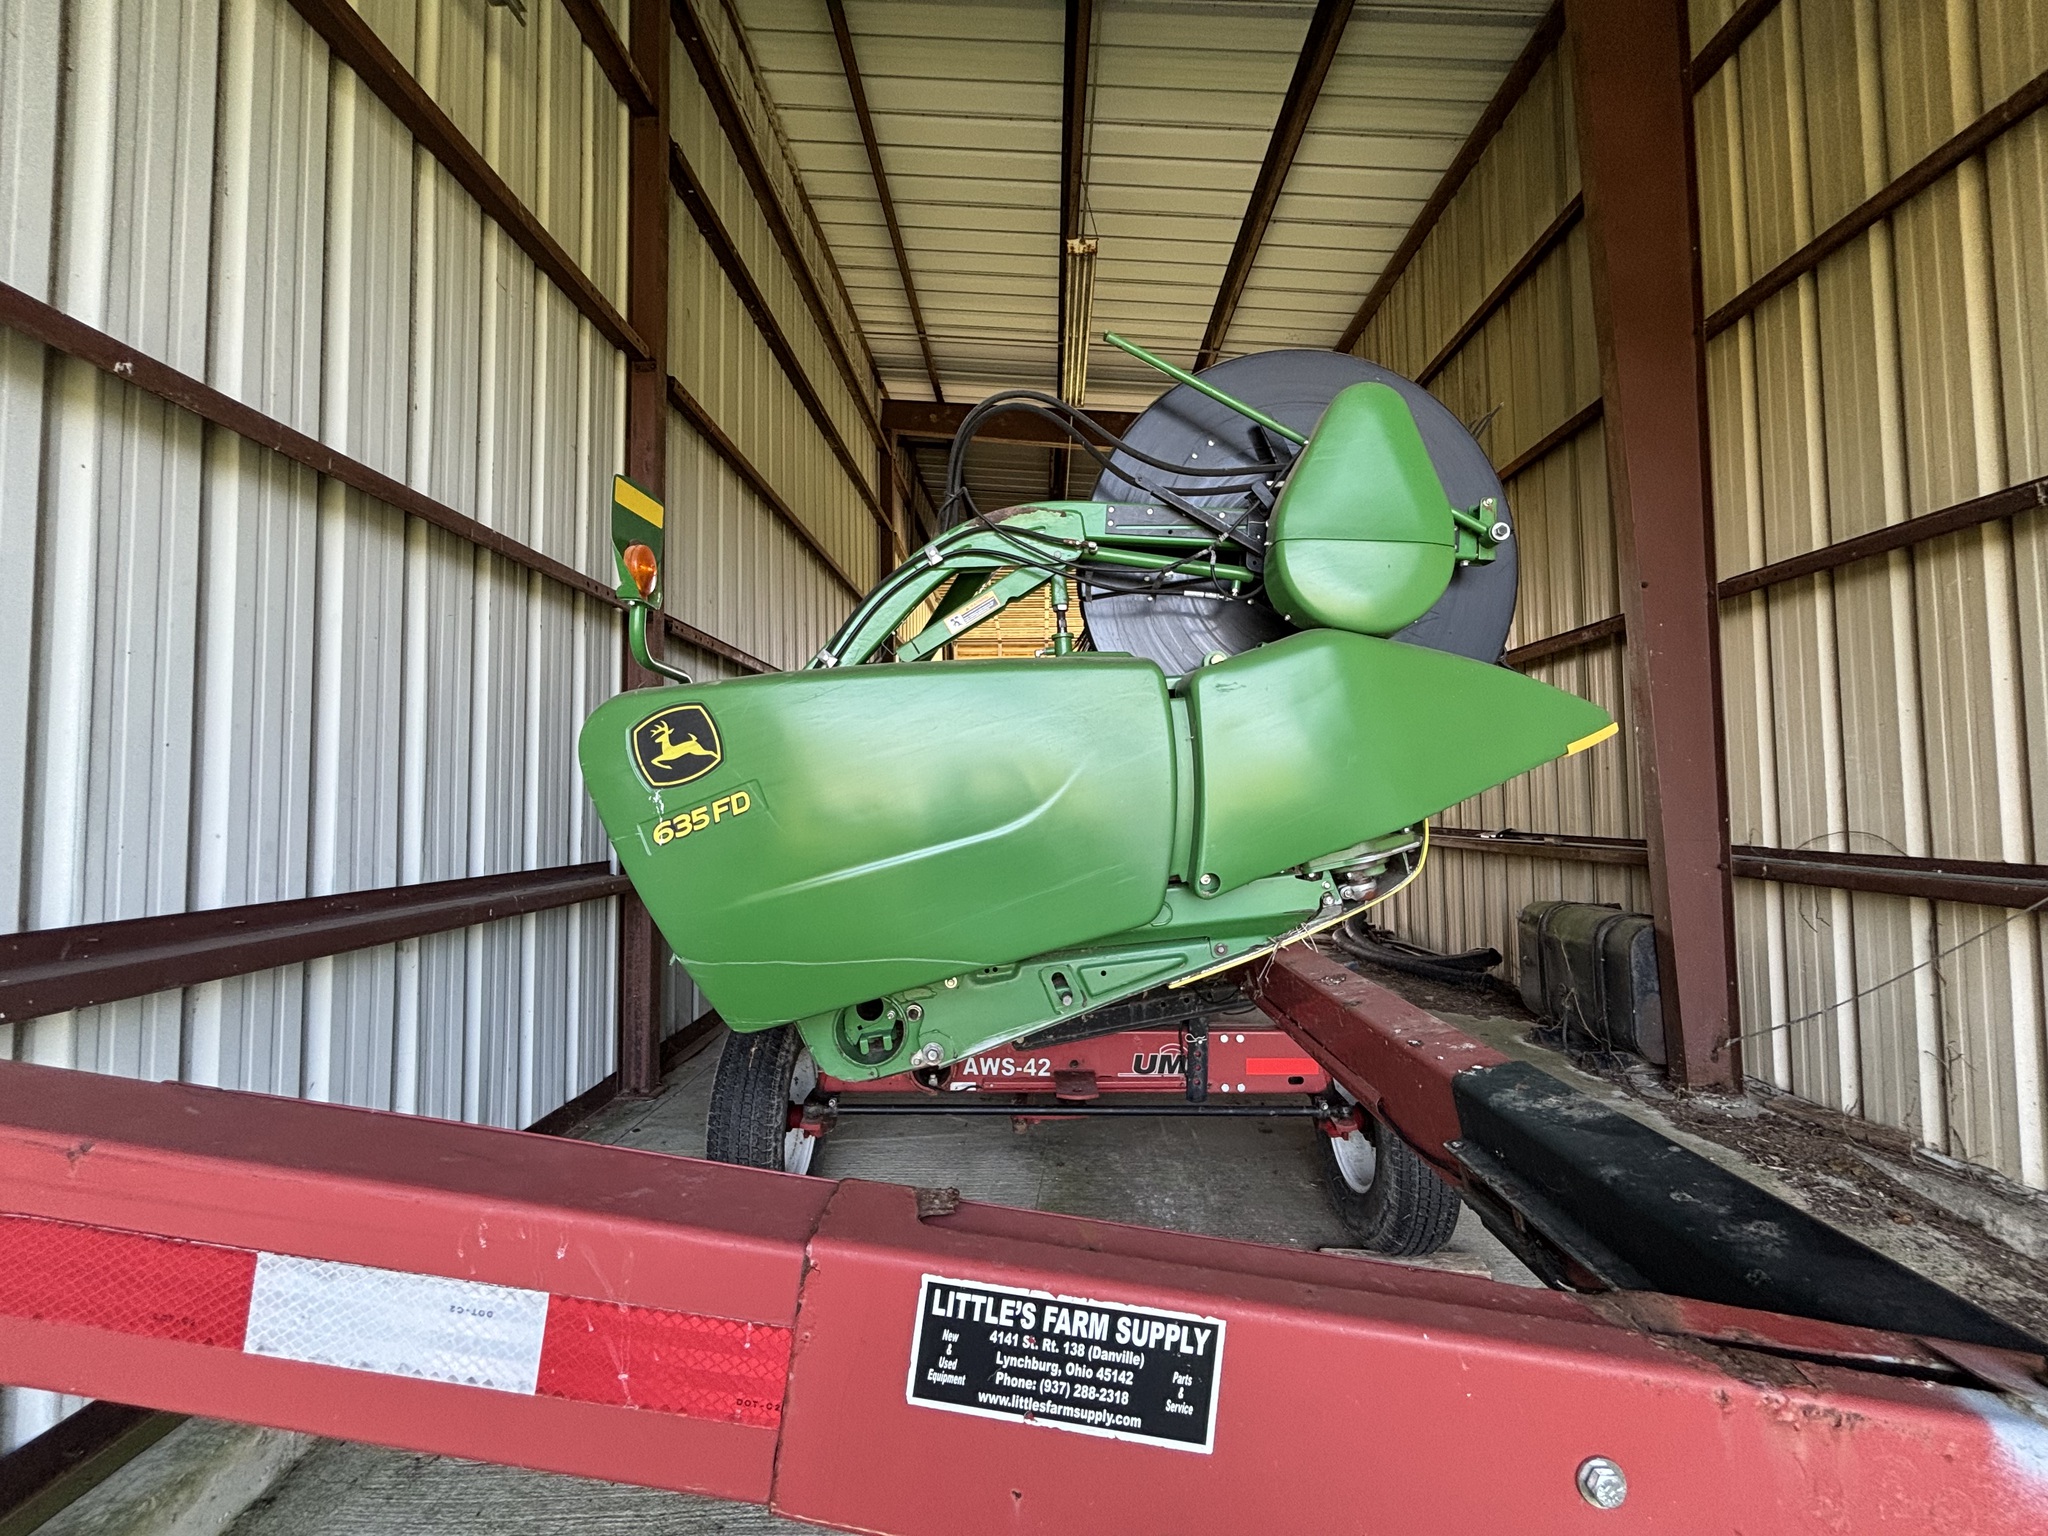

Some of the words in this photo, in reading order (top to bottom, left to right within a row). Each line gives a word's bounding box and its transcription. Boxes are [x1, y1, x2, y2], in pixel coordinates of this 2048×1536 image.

[962, 1057, 1051, 1077] AWS-42
[449, 1305, 494, 1319] DOT-C2
[931, 1288, 1037, 1330] LITTLE'S
[1042, 1305, 1110, 1342] FARM
[1115, 1316, 1212, 1356] SUPPLY
[942, 1328, 960, 1343] New
[946, 1343, 953, 1356] &
[989, 1330, 1019, 1347] 4141
[1042, 1338, 1060, 1353] Rt.
[1063, 1341, 1085, 1357] 138
[1088, 1345, 1145, 1369] (Danville)
[938, 1356, 959, 1371] Used
[995, 1351, 1062, 1377] Lynchburg,
[1065, 1362, 1094, 1379] Ohio
[1096, 1367, 1134, 1385] 45142
[927, 1368, 967, 1386] Equipment
[1172, 1371, 1193, 1386] Parts
[995, 1372, 1037, 1391] Phone:
[1039, 1378, 1071, 1399] (937)
[1073, 1384, 1130, 1406] 288-2318
[1177, 1386, 1185, 1400] &
[736, 1398, 781, 1411] DOT-C2
[977, 1391, 1142, 1429] www.littlesfarmsupply.com
[1165, 1399, 1194, 1416] Service
